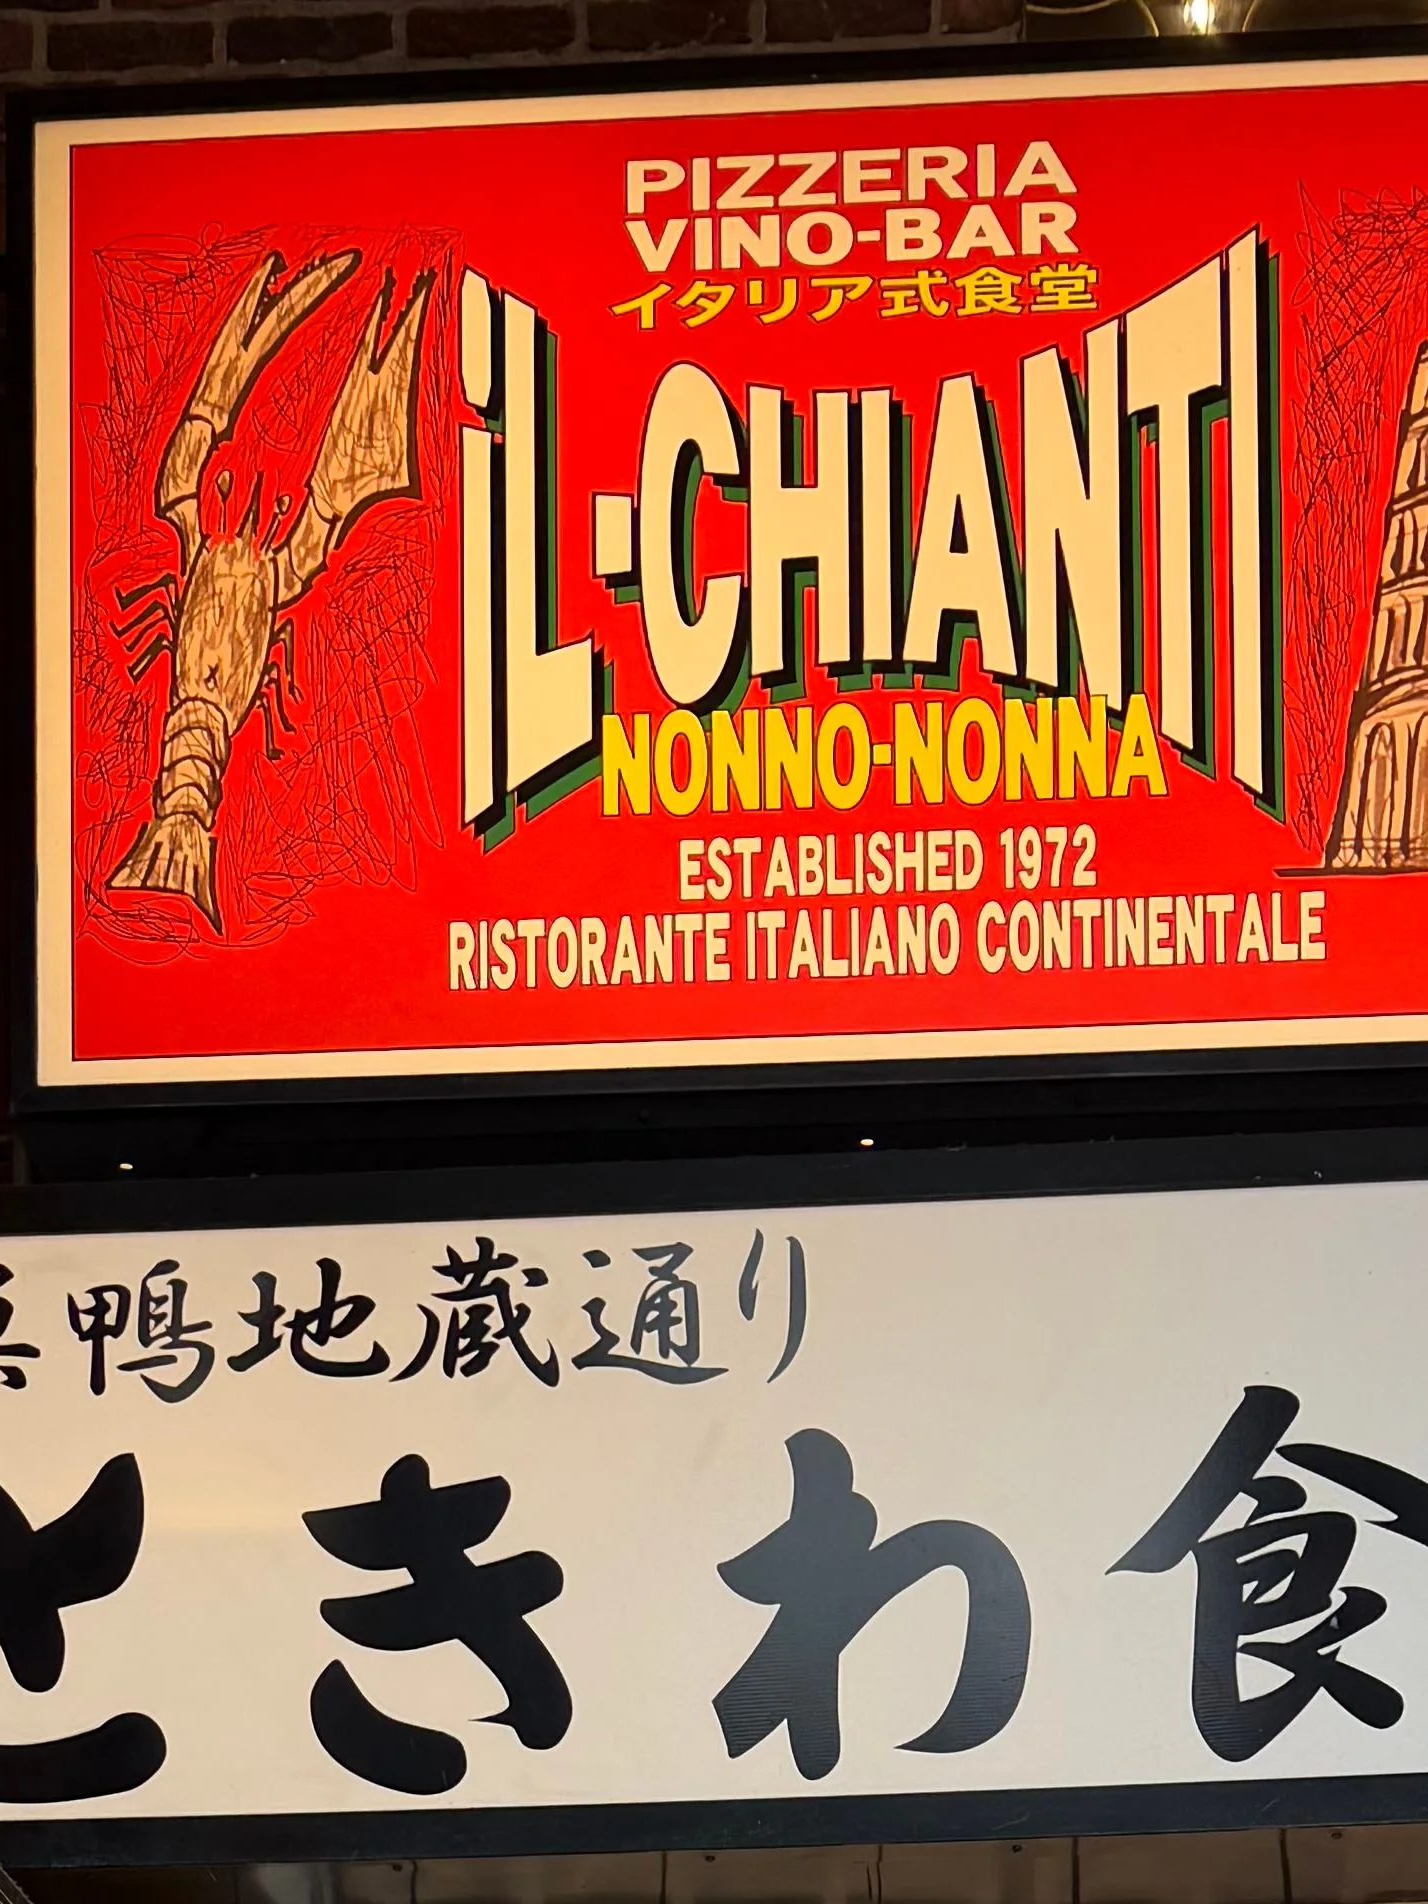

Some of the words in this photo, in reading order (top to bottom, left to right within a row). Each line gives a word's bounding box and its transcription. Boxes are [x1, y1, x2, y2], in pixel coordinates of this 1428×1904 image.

[624, 140, 1078, 214] PIZZERIA
[626, 202, 1078, 273] VINO-BAR
[611, 262, 1102, 328] イタリア式食堂
[599, 693, 1169, 818] NONNO-NONNA
[677, 835, 986, 902] ESTABLISHED
[999, 824, 1099, 886] 1972
[446, 913, 729, 993] RISTORANTE
[743, 902, 963, 979] ITALIANO
[975, 891, 1328, 972] CONTINENTALE
